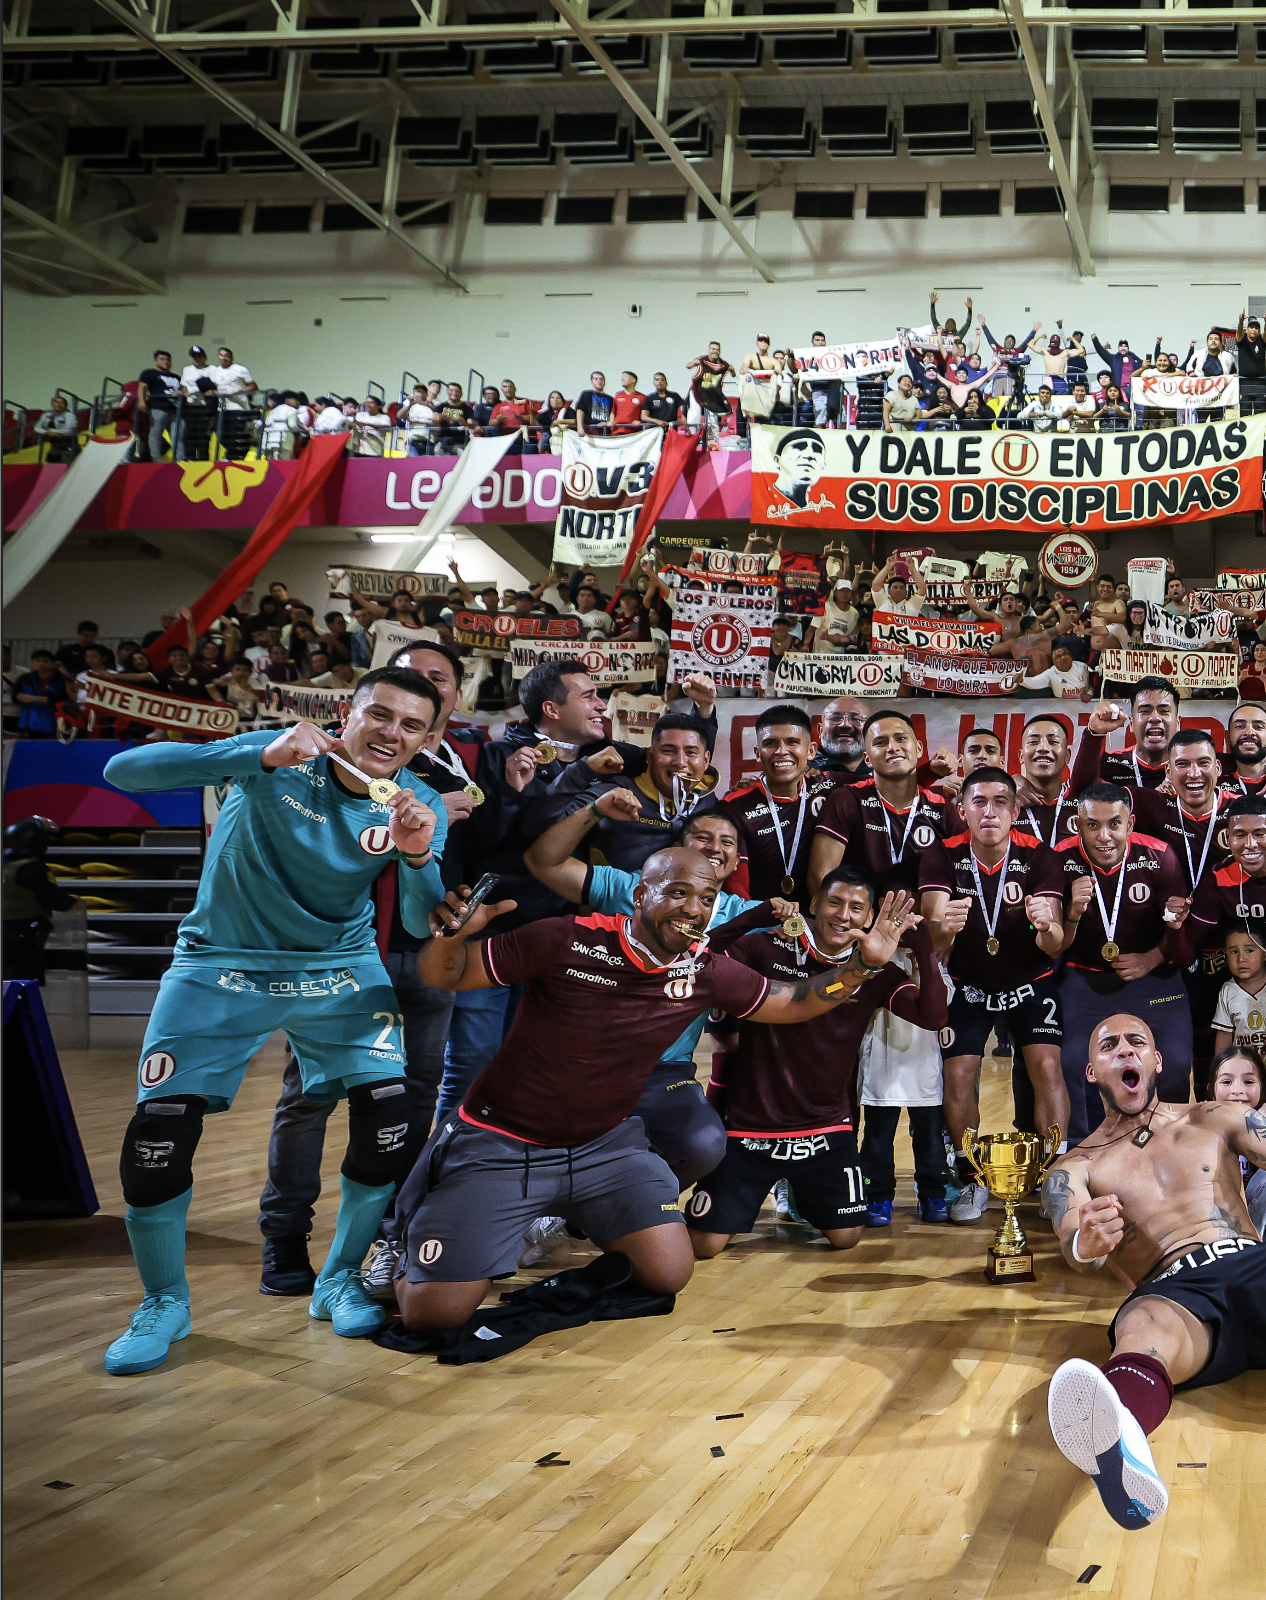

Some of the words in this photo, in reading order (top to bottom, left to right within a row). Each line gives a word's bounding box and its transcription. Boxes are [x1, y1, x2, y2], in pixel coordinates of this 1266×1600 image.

[1142, 377, 1229, 396] RUGIDO
[846, 434, 870, 472] Y
[880, 437, 981, 475] DALE
[1051, 438, 1103, 477] EN
[1115, 421, 1247, 475] TODAS
[847, 483, 940, 524] SUS
[950, 467, 1241, 525] DISCIPLINAS
[560, 505, 643, 541] NORT
[660, 536, 710, 546] CAMPEONES
[1061, 566, 1079, 574] 1994
[676, 592, 702, 605] LOS
[708, 595, 773, 610] FULEROS
[455, 611, 581, 637] CRUELES
[893, 616, 920, 626] VILLA
[493, 636, 508, 649] EL
[534, 640, 583, 649] CERCADO
[590, 641, 604, 649] DE
[608, 641, 636, 650] LIMA
[878, 624, 909, 645] LAS
[915, 630, 995, 651] DUNAS
[907, 652, 920, 666] EL
[923, 656, 958, 672] AMOR
[962, 661, 987, 674] QUE
[990, 660, 1024, 674] TODO
[1105, 650, 1121, 670] LOS
[1208, 656, 1235, 677] NORTE
[937, 677, 953, 690] LO
[957, 680, 989, 693] CURA
[138, 695, 190, 721] TODO
[281, 794, 327, 825] marathon
[269, 969, 352, 992] COLECTIVO
[565, 967, 618, 987] marathon
[1042, 998, 1057, 1026] 2
[1032, 1026, 1063, 1036] marathon
[843, 1167, 864, 1203] 11
